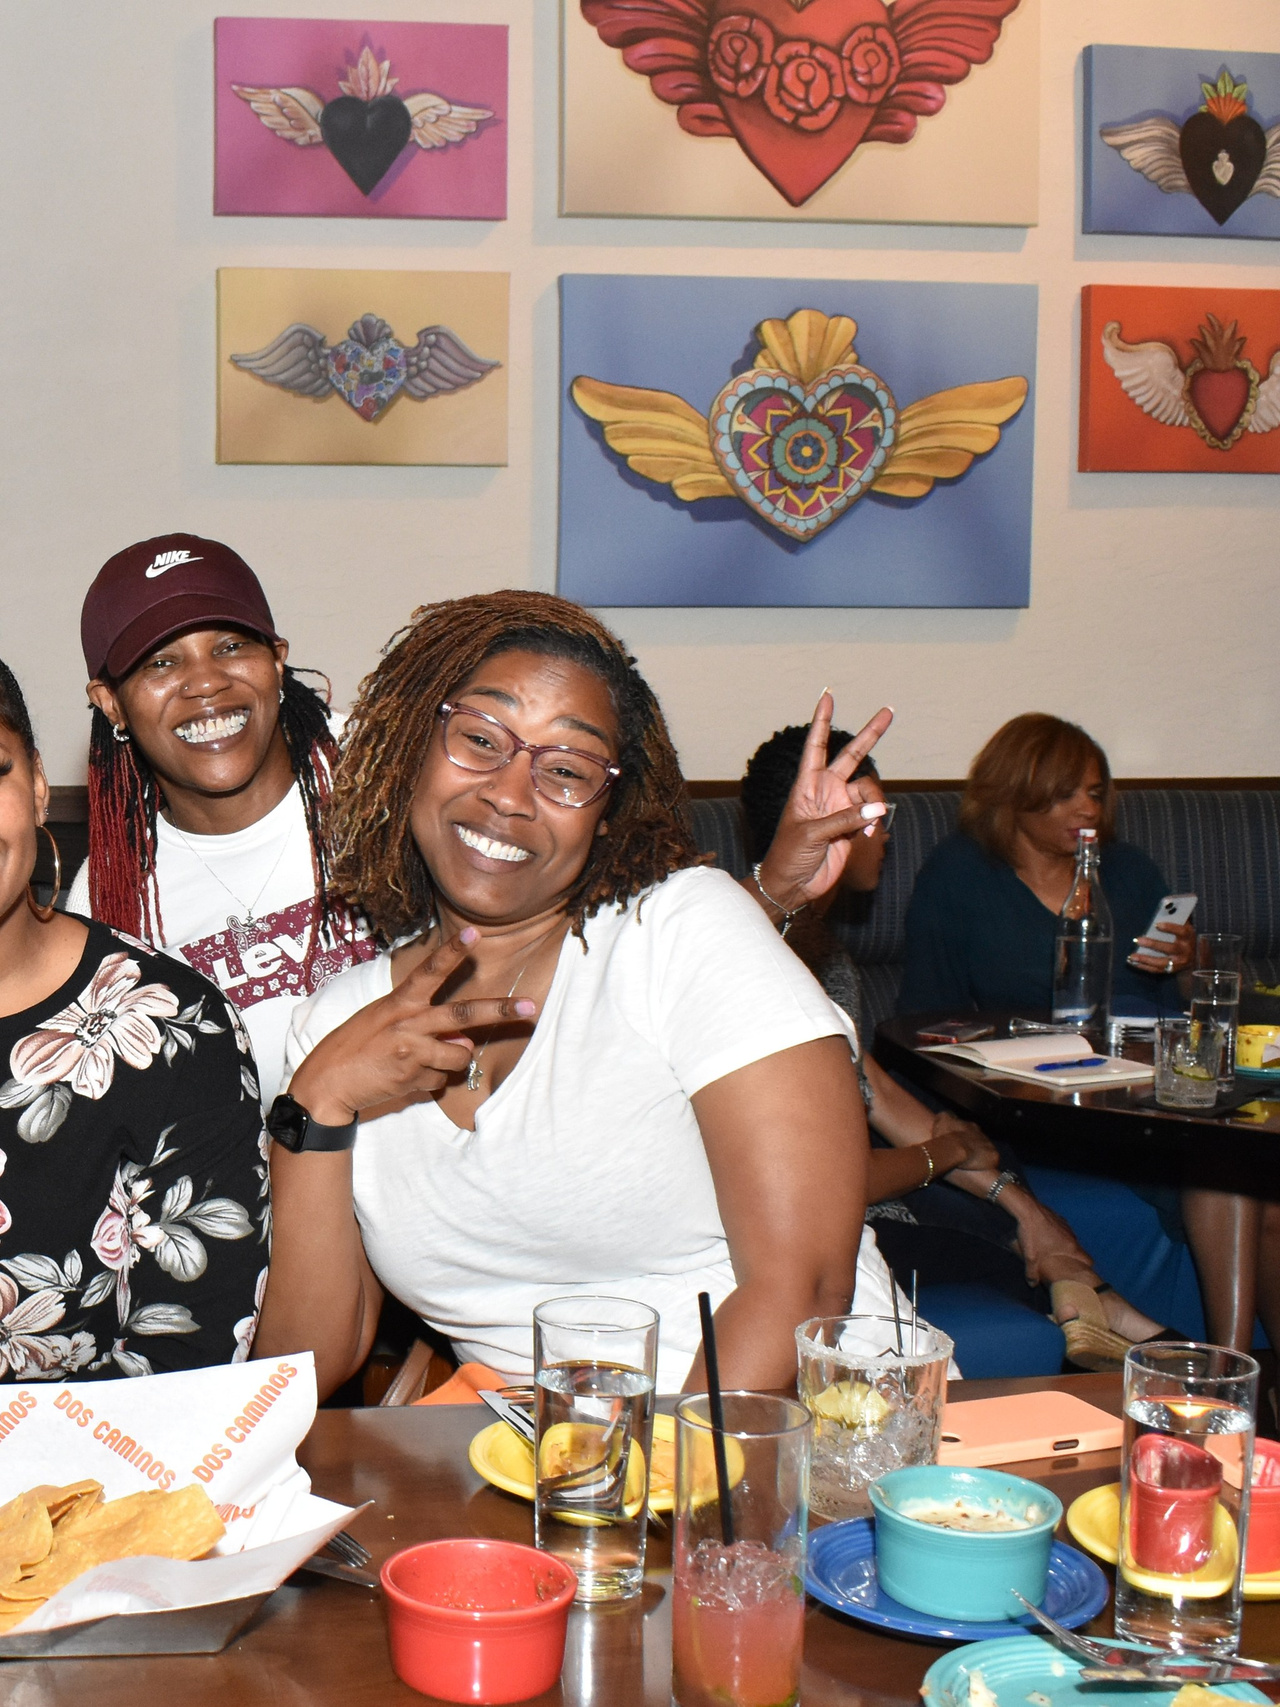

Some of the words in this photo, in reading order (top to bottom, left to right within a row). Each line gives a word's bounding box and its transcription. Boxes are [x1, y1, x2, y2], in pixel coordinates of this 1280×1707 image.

[153, 550, 191, 568] NIKE
[53, 1389, 94, 1428] DOS
[92, 1420, 177, 1490] CAMINOS
[191, 1443, 233, 1484] DOS
[224, 1362, 298, 1443] CAMINOS
